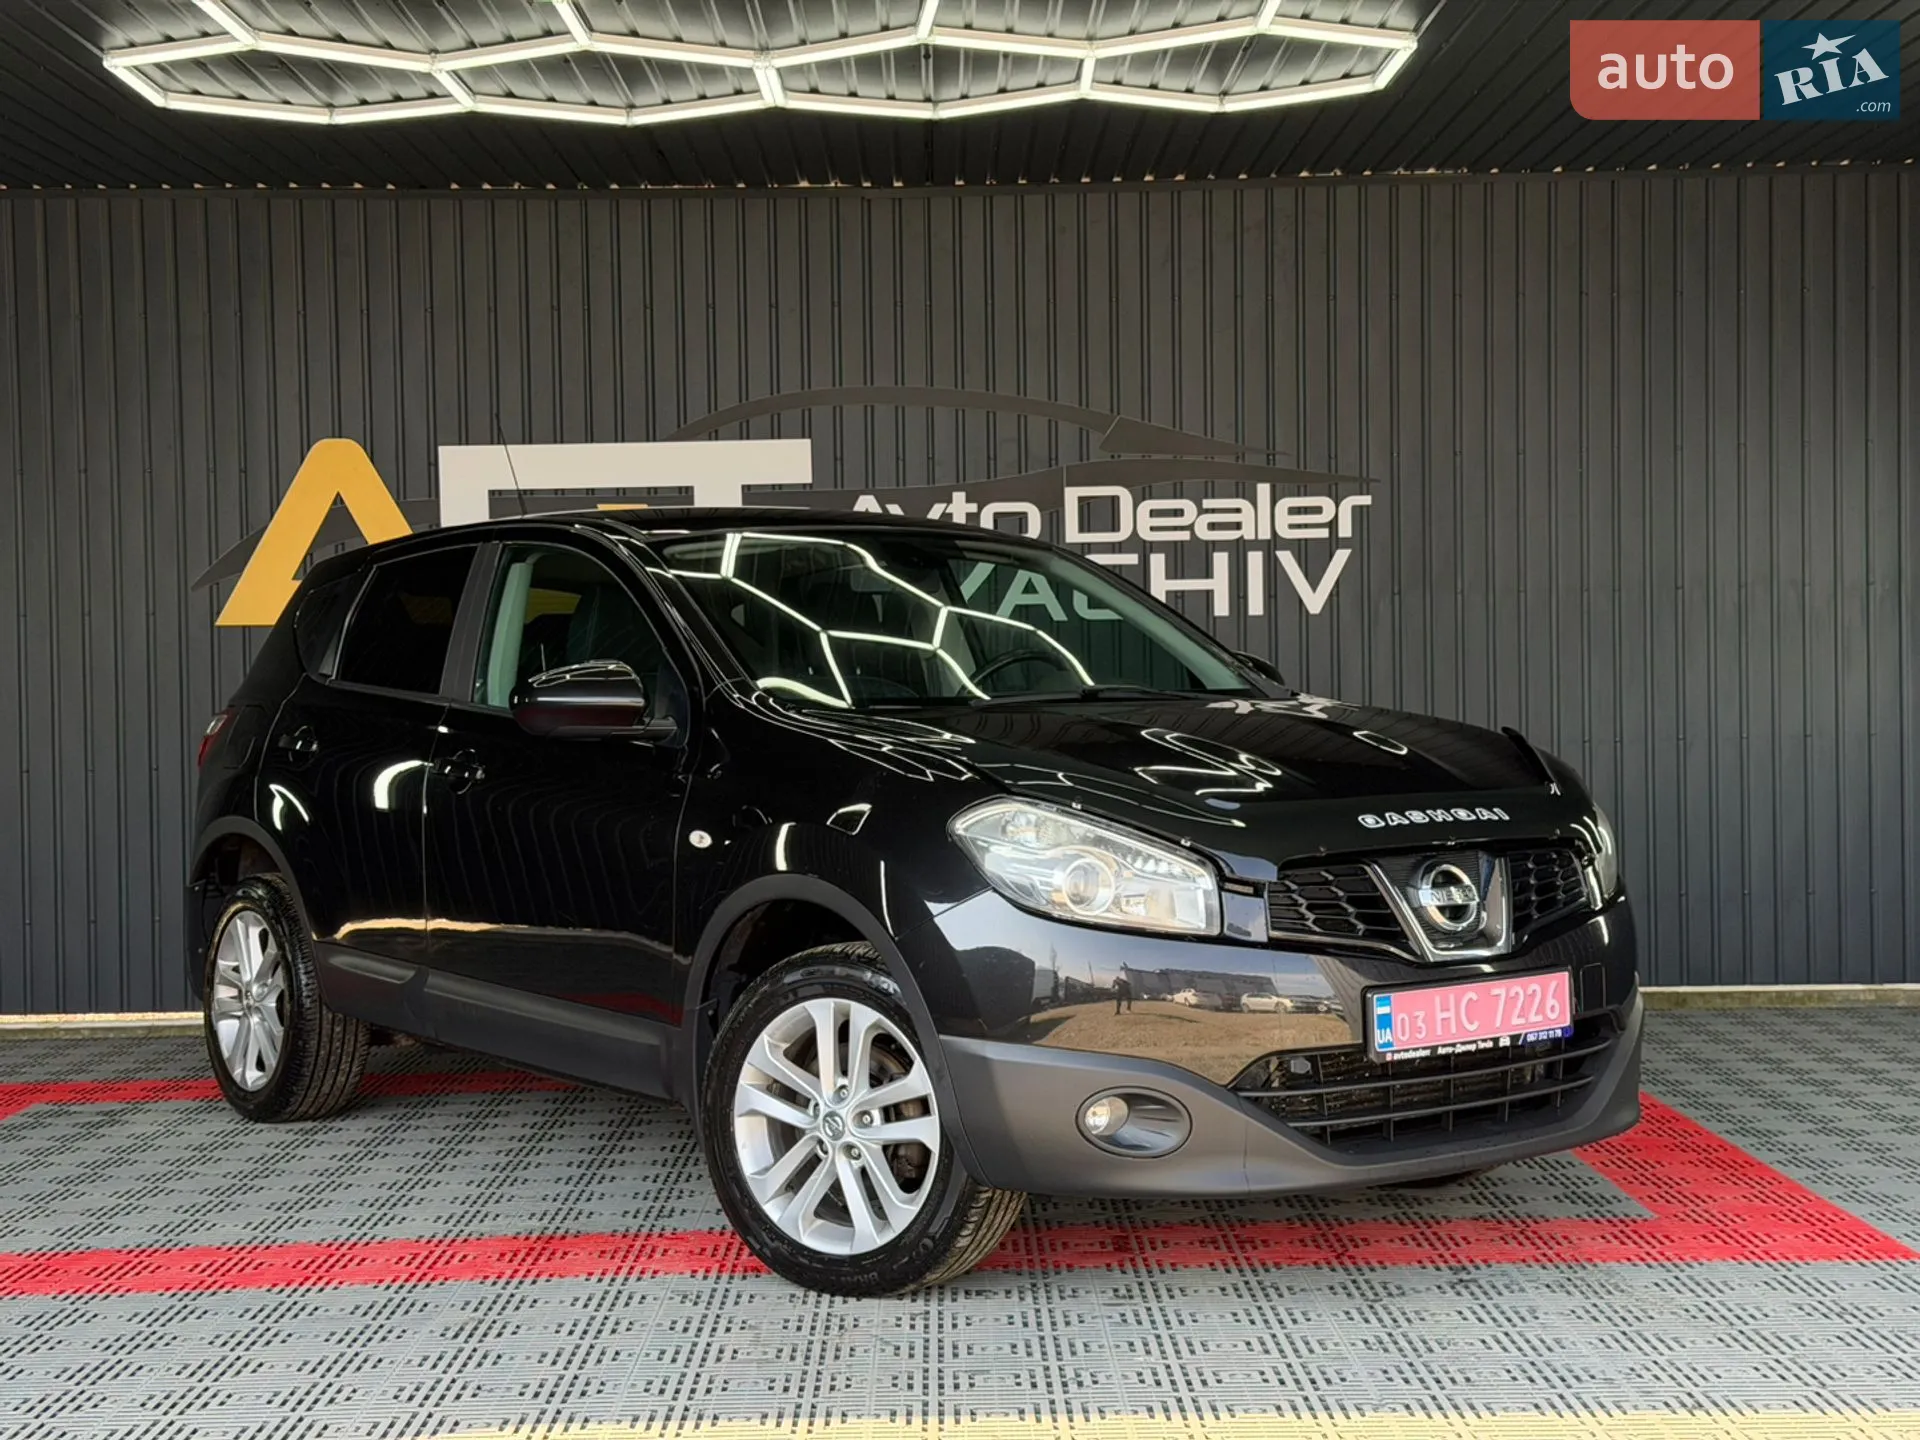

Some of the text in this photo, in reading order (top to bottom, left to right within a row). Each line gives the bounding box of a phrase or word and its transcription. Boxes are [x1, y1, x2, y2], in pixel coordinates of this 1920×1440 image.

[1064, 483, 1372, 543] Dealer
[1358, 807, 1511, 828] QASHQAI
[1397, 980, 1561, 1042] 03 HC 7226
[1377, 1028, 1393, 1044] UA
